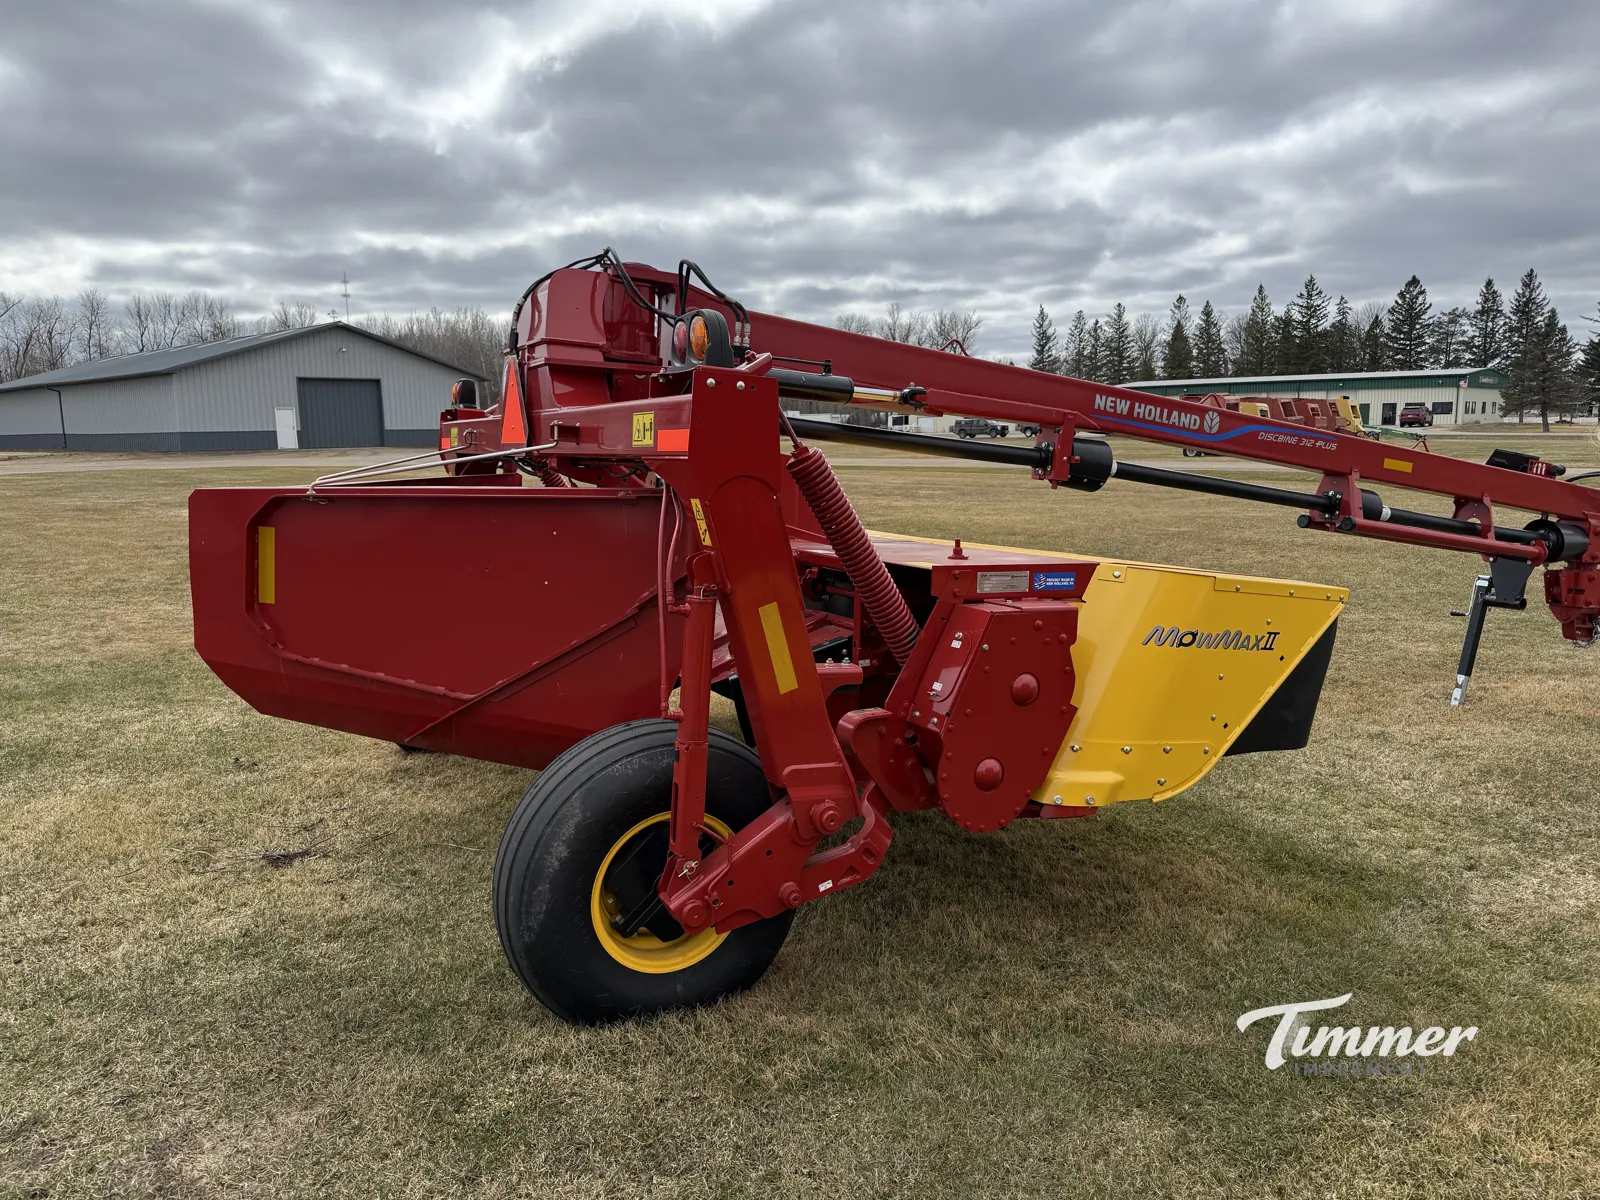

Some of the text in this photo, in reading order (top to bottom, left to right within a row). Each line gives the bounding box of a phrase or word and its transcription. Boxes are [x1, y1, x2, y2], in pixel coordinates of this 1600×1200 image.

[1094, 394, 1200, 430] NEW HOLLAND
[1258, 431, 1298, 444] DISCBINE
[1300, 438, 1315, 447] 312
